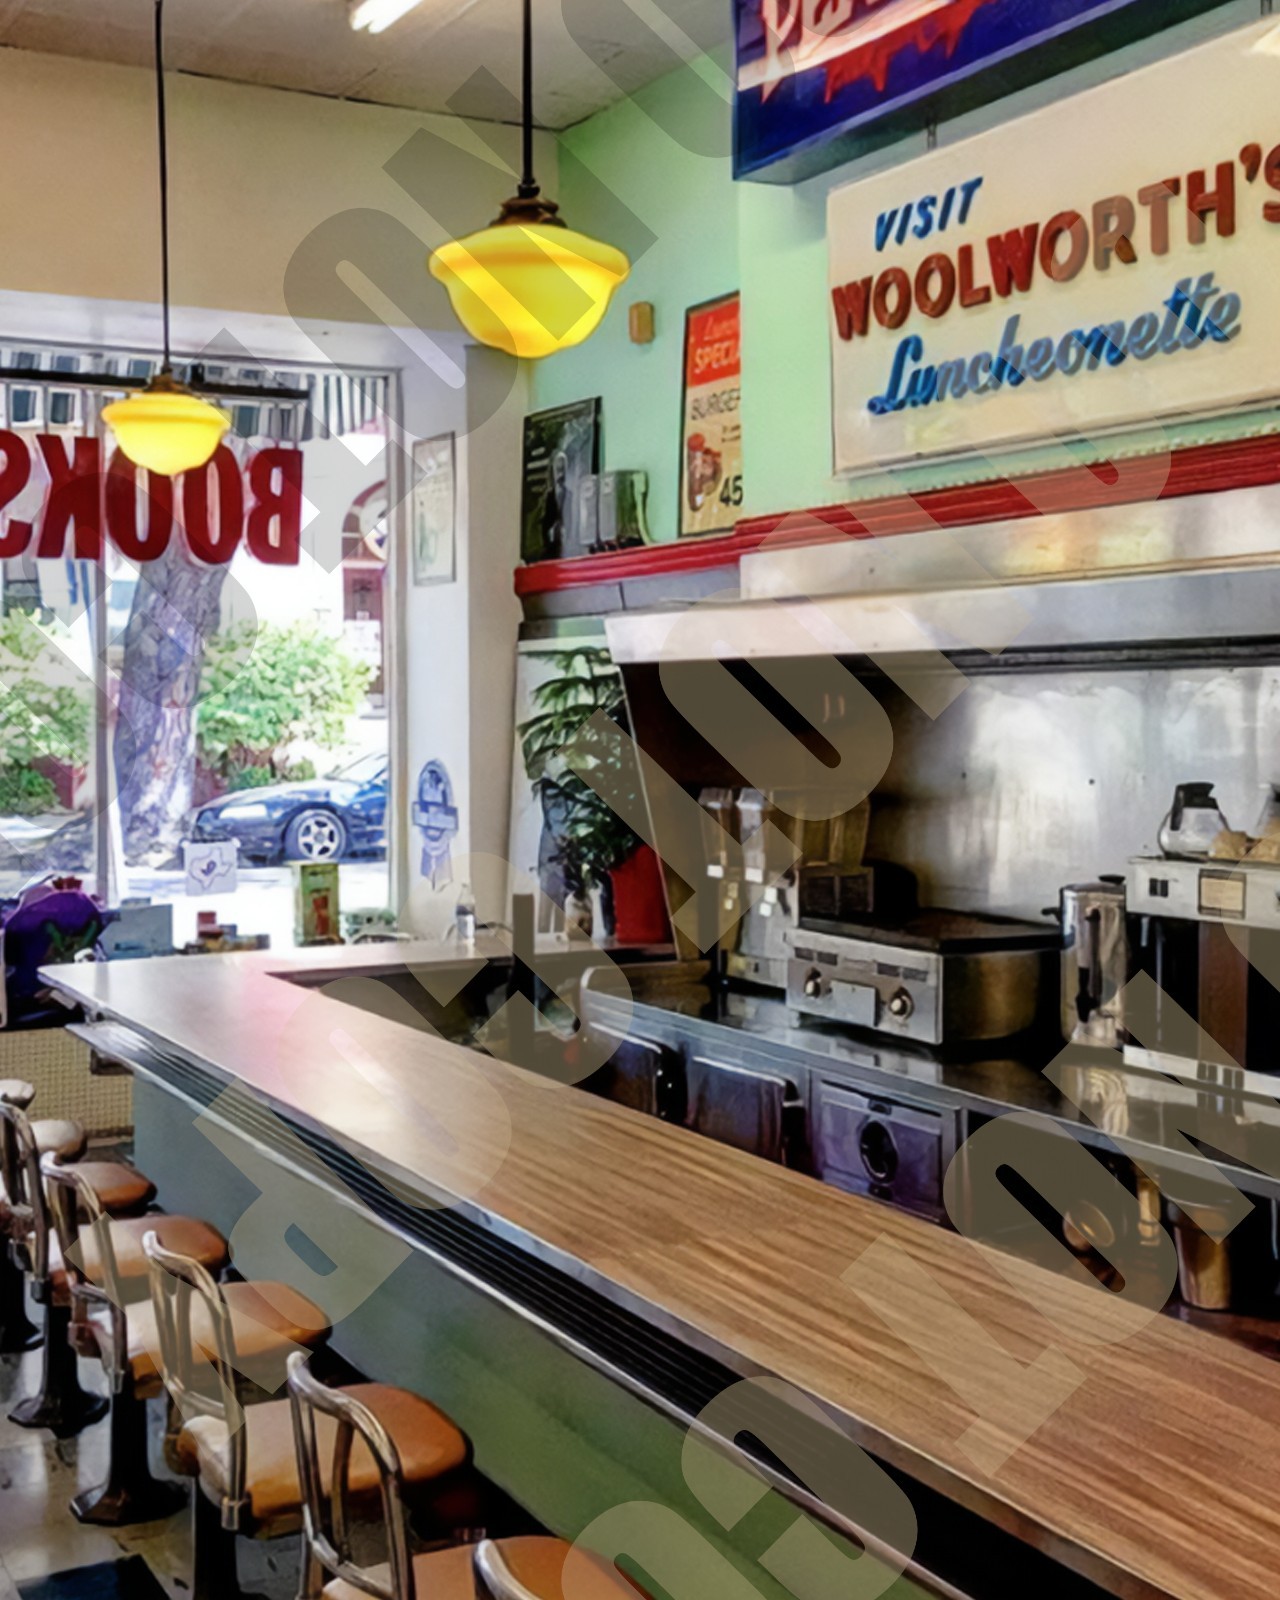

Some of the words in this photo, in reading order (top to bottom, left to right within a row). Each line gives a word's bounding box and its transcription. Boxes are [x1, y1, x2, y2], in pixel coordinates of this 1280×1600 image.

[875, 176, 983, 252] VISIT
[867, 272, 1241, 415] Luncheonette
[719, 474, 744, 507] 45
